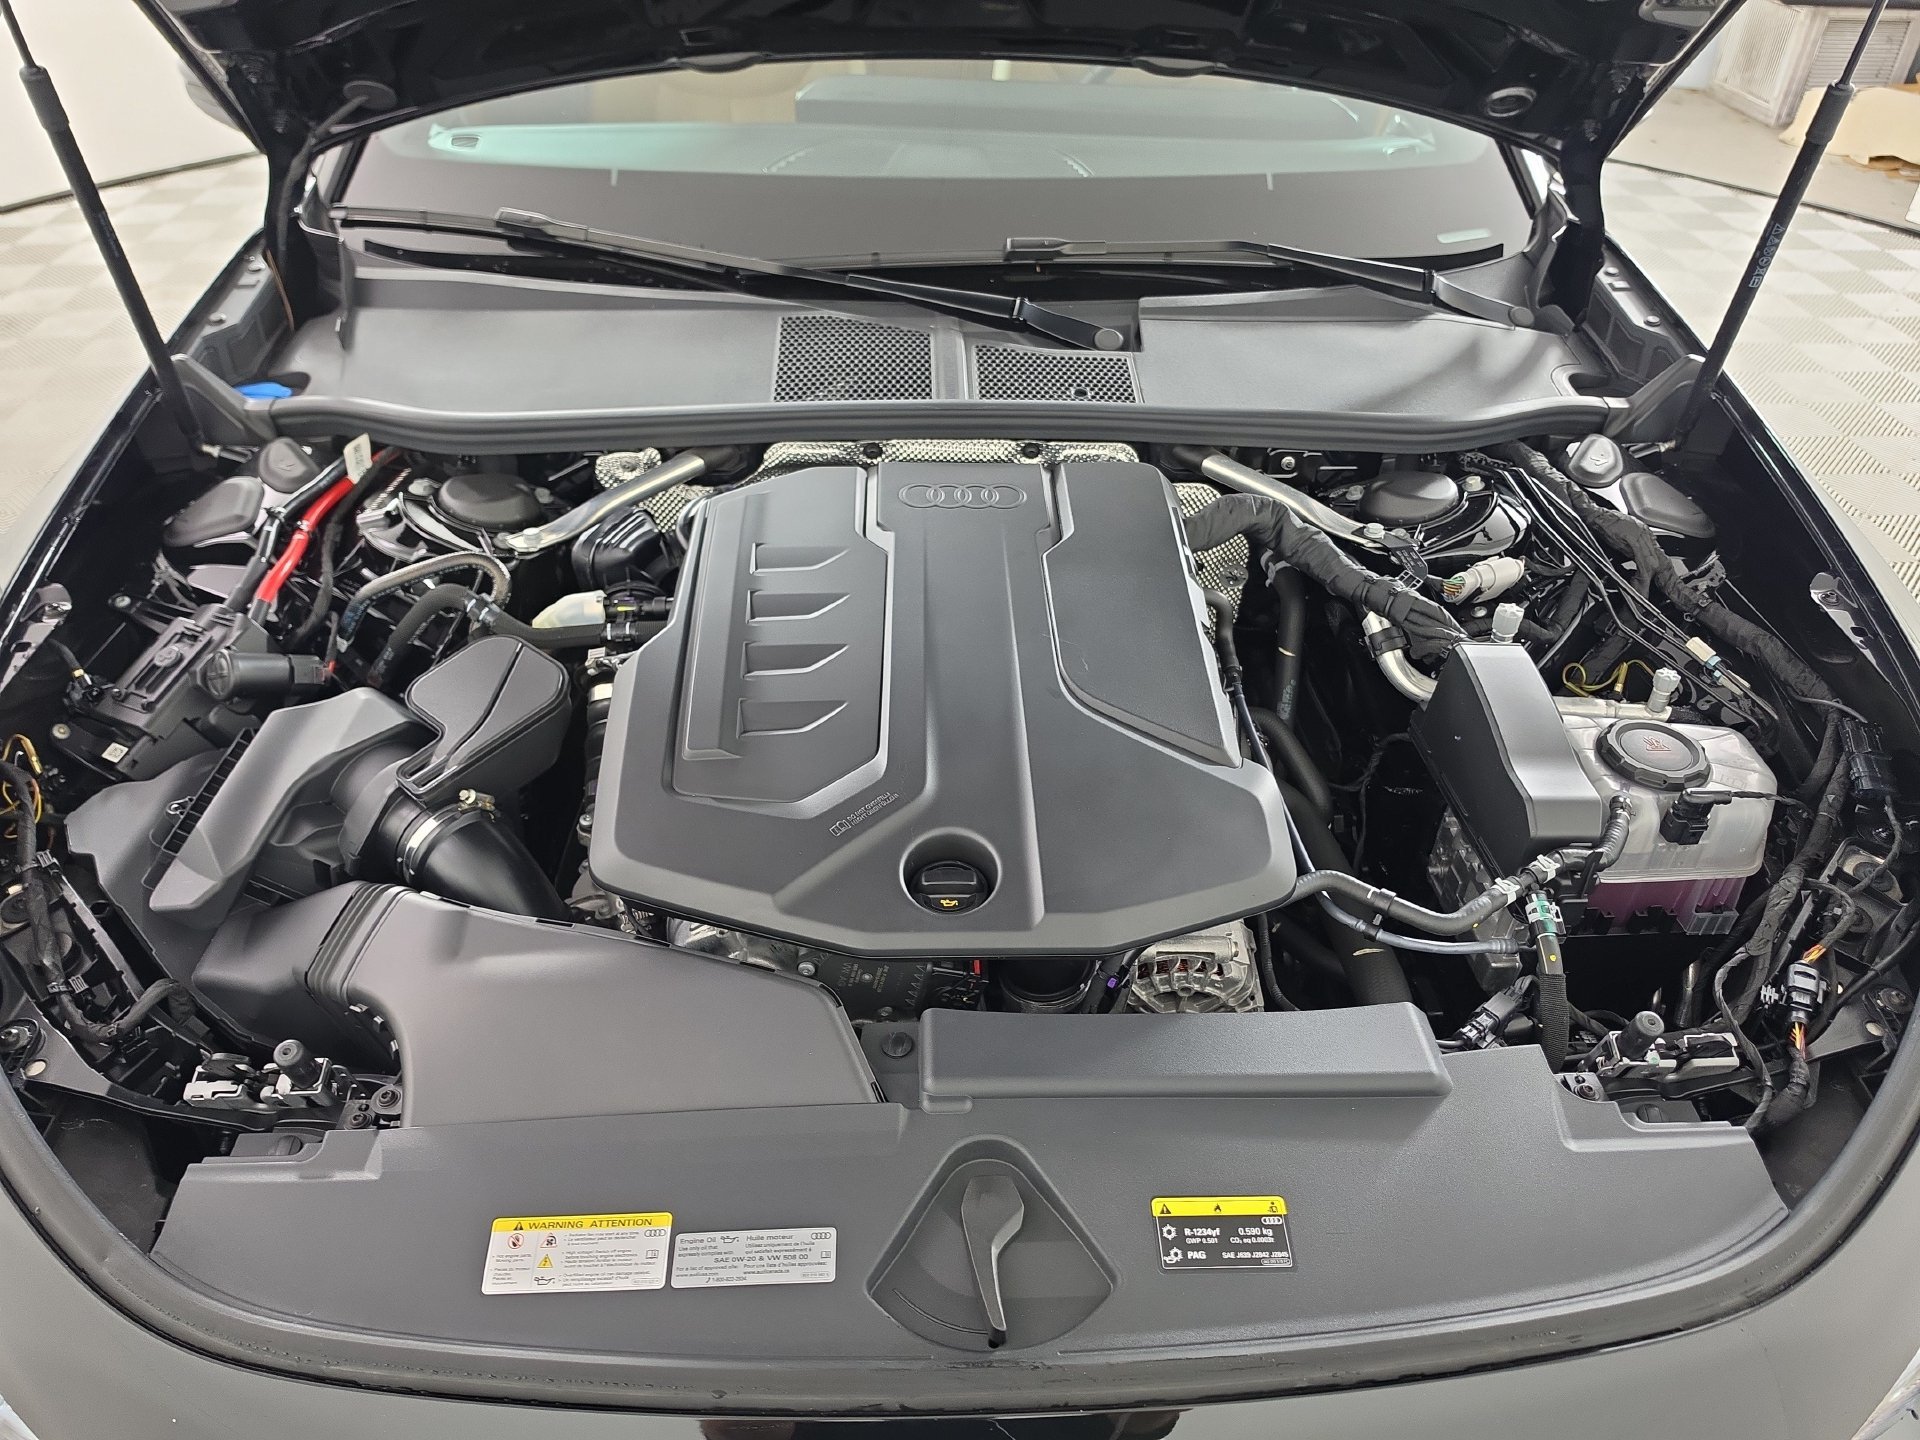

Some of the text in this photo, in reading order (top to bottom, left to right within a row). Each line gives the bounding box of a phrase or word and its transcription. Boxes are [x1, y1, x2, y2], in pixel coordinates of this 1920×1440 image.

[528, 1218, 652, 1230] WARNING ATTENTION
[1184, 1228, 1221, 1237] R-1234yf
[1262, 1227, 1273, 1236] kg
[1187, 1251, 1207, 1259] PAG
